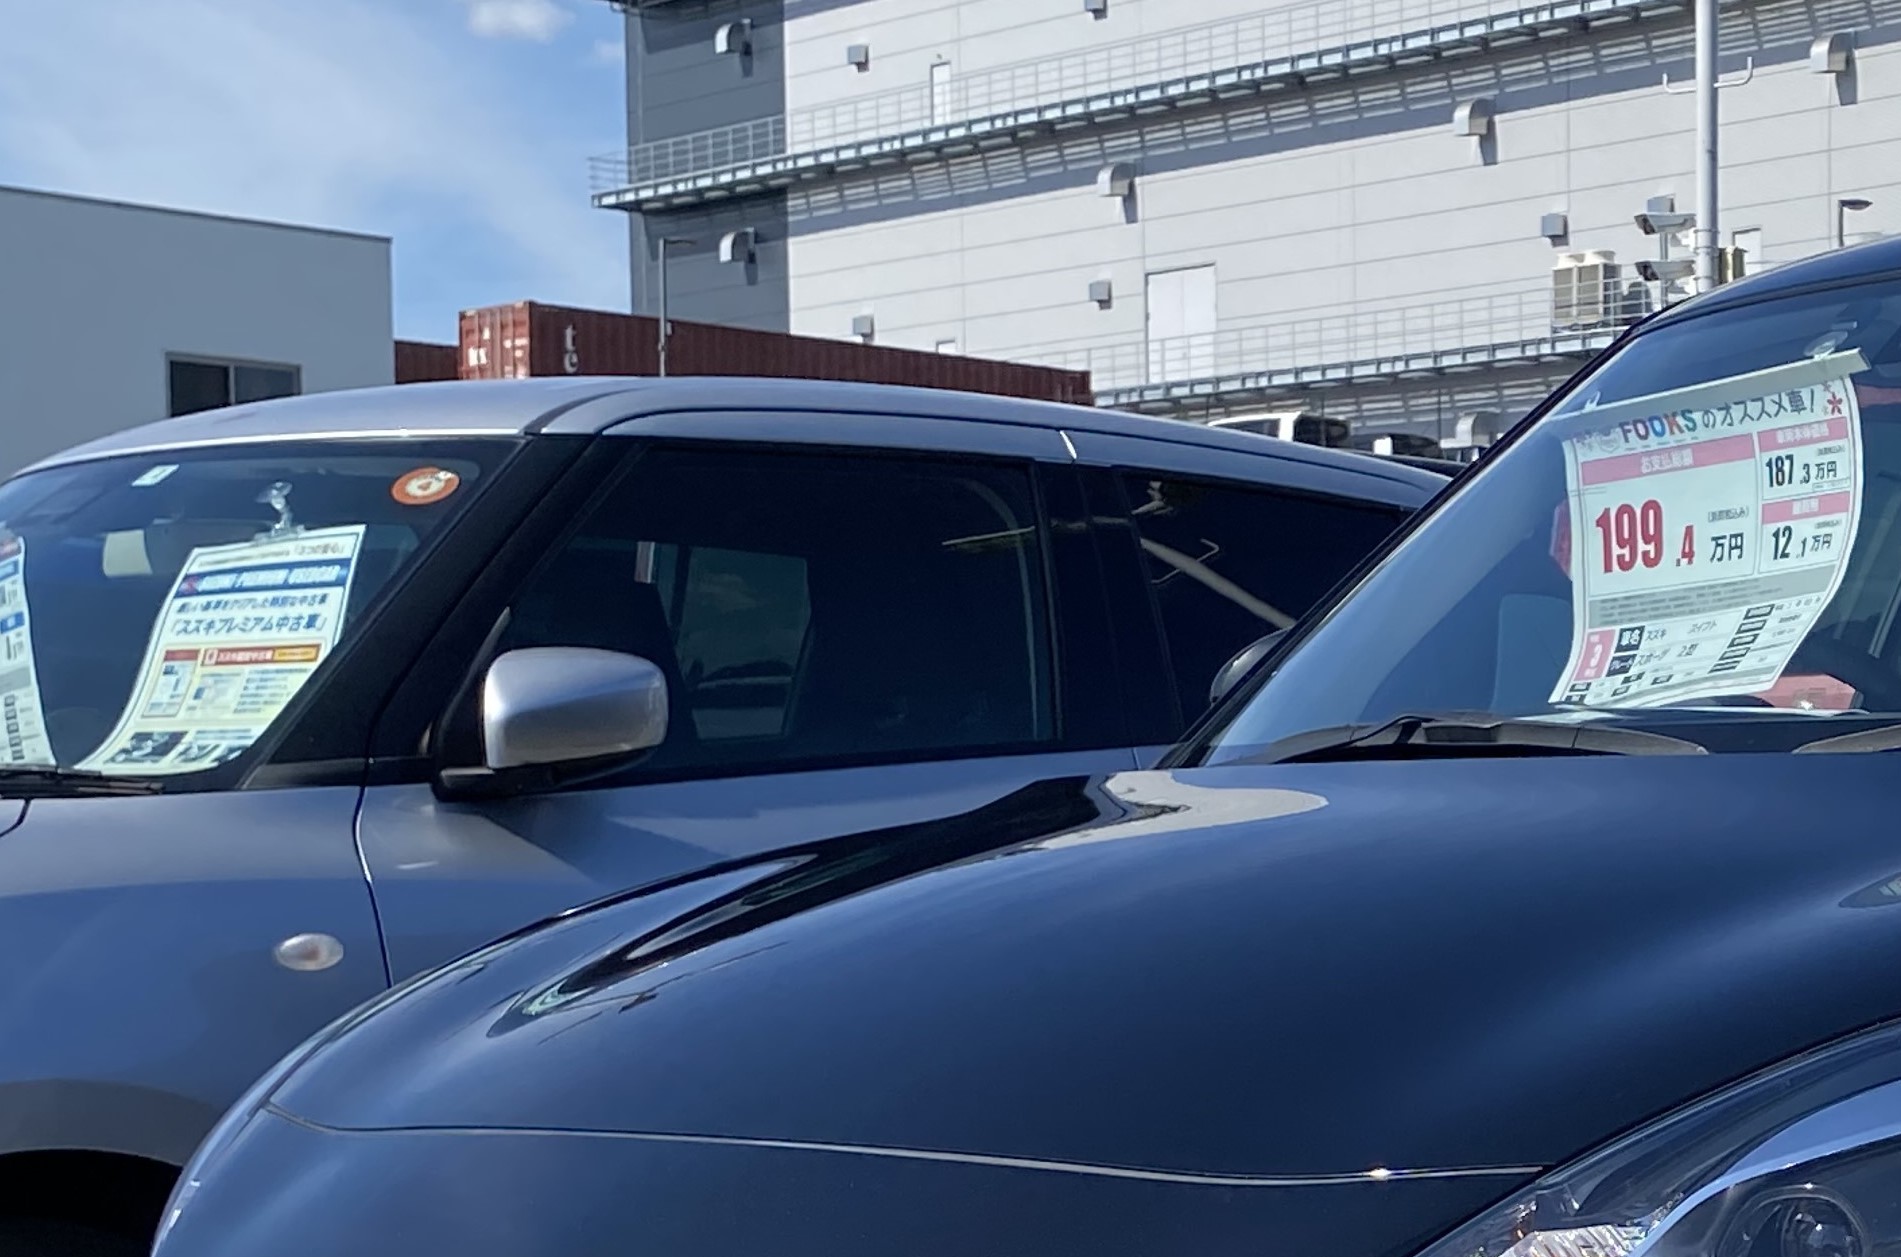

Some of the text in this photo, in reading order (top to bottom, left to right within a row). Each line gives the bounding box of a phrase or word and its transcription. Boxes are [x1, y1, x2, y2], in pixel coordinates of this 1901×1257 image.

[1815, 461, 1837, 480] 万円
[1710, 532, 1744, 563] 万円
[1810, 533, 1833, 552] 万円
